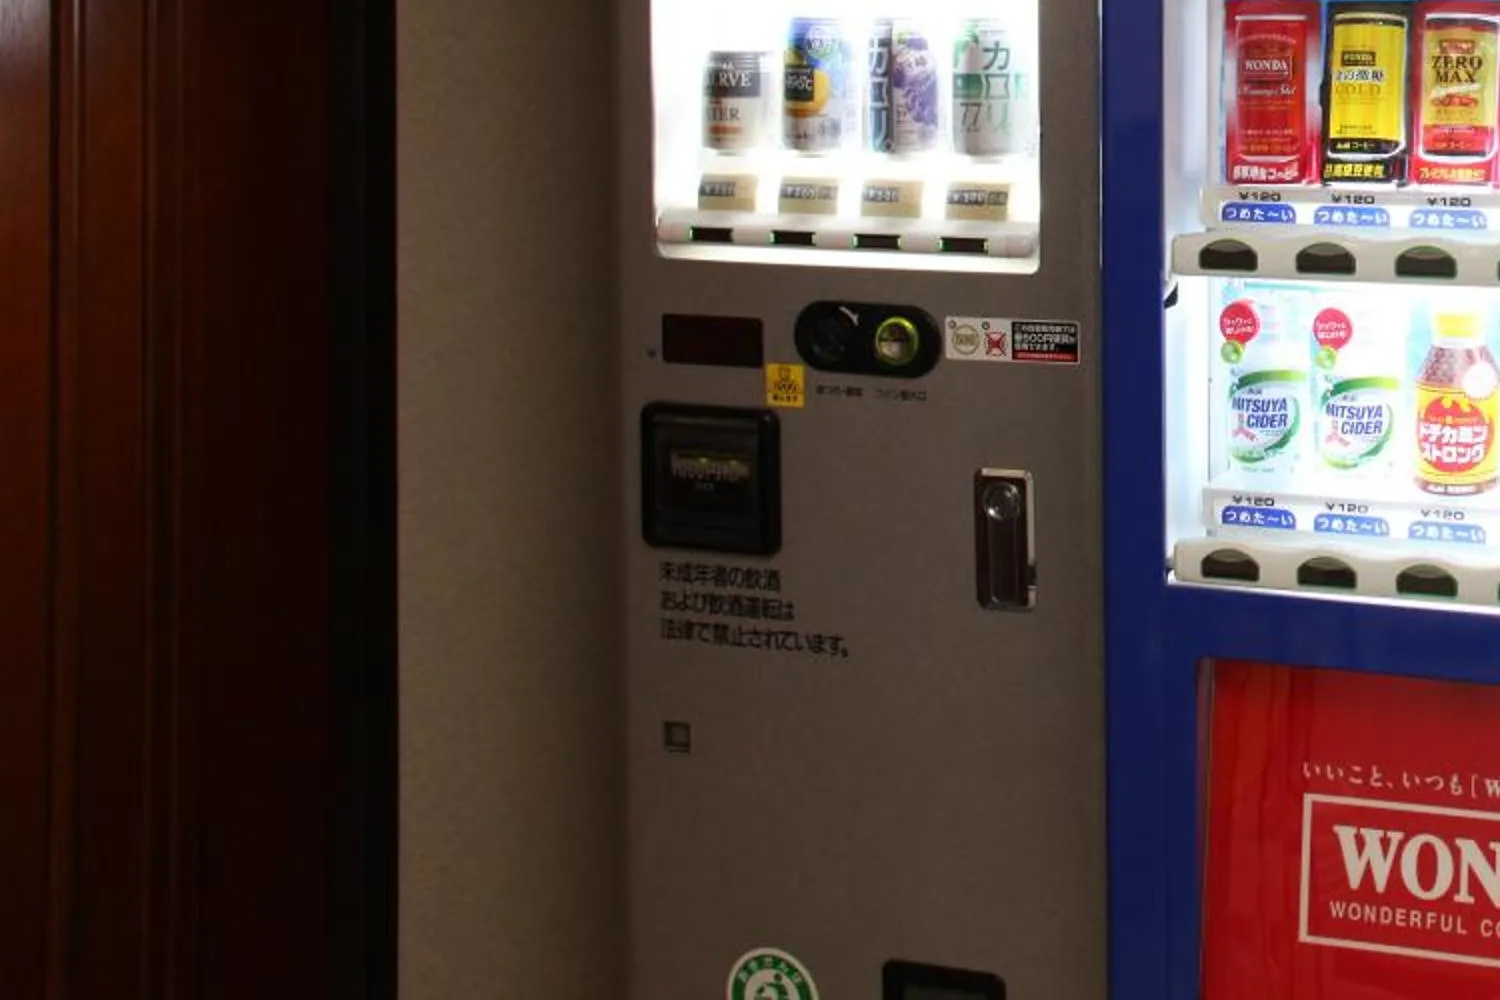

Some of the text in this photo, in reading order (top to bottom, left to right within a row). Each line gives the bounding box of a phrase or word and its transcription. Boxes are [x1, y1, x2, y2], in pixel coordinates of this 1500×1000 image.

[1431, 56, 1484, 70] ZERO
[1437, 69, 1477, 83] MAX
[1239, 191, 1282, 203] ¥120
[1331, 194, 1376, 206] ¥120
[1427, 196, 1472, 208] ¥120
[1232, 397, 1288, 413] MITSUYA
[1325, 403, 1384, 419] MITSUYA
[1246, 413, 1289, 429] CIDER
[1341, 419, 1384, 435] CIDER
[1232, 495, 1275, 507] ¥120
[1325, 501, 1369, 514] ¥120
[1420, 508, 1465, 521] ¥120
[1329, 900, 1468, 936] WONDERFUL
